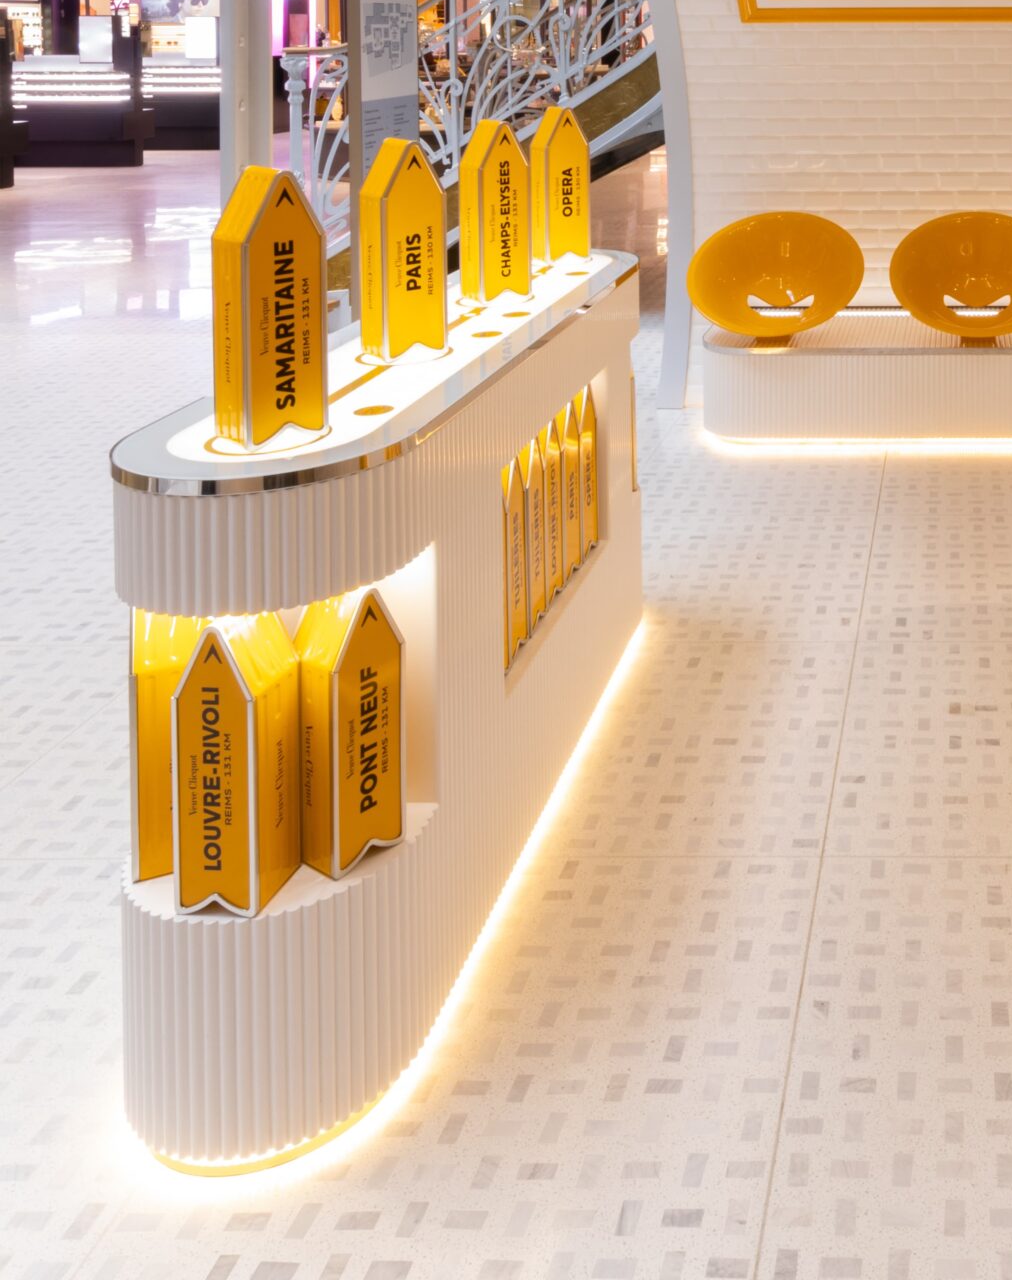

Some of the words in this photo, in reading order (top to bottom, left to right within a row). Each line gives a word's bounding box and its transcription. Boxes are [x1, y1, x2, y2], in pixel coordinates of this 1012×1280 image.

[562, 167, 573, 218] OPERA
[406, 233, 421, 292] PARIS
[302, 278, 309, 294] KM
[274, 240, 296, 410] SAMARITAINE
[302, 298, 310, 319] 131
[360, 666, 378, 736] NEUF
[381, 686, 388, 704] KM
[381, 707, 389, 729] 131
[223, 733, 231, 751] KM
[381, 737, 389, 774] REIMS
[202, 686, 222, 871] LOUVRE-RIVOLI
[224, 755, 232, 778] 131
[360, 740, 378, 815] PONT
[224, 789, 232, 826] REIMS
